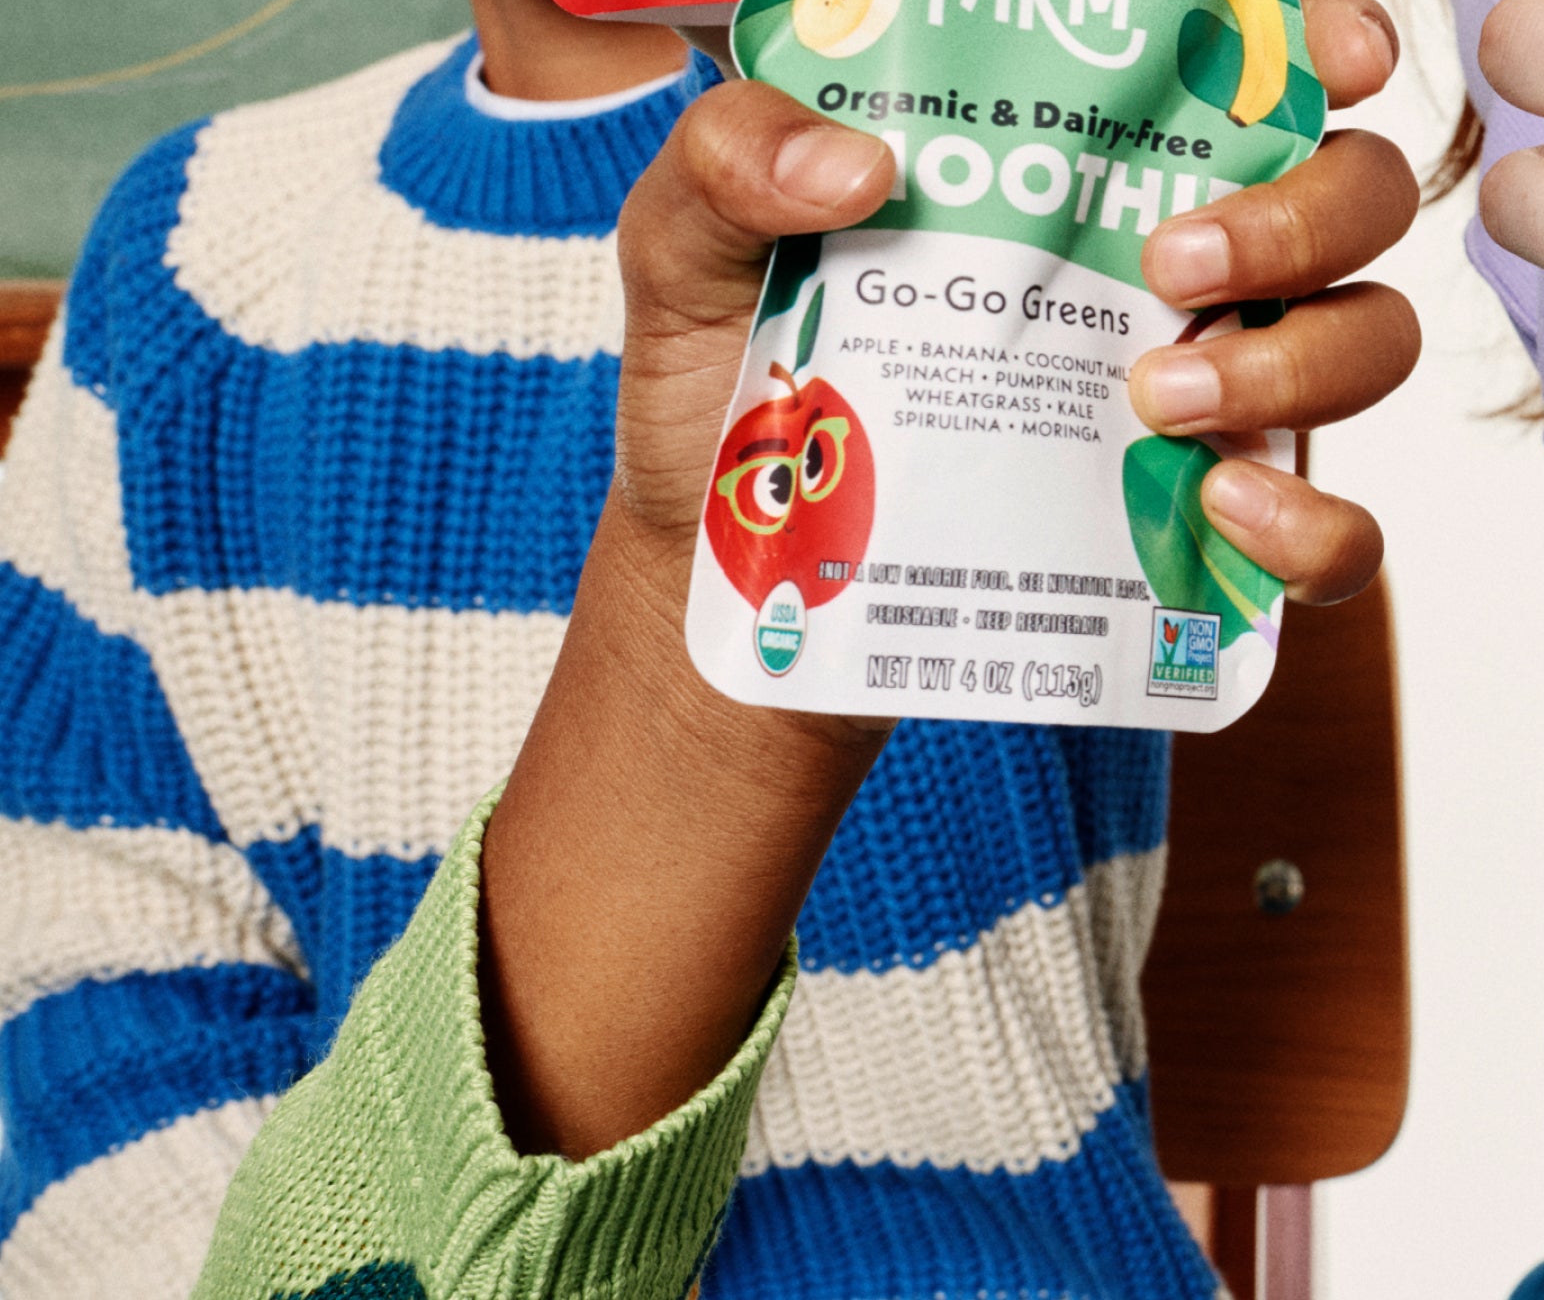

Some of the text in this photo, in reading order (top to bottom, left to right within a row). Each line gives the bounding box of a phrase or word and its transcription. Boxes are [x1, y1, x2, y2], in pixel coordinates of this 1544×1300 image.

[816, 82, 1214, 161] Organic & Dairy-Free
[879, 131, 1244, 237] OOTHI
[856, 269, 1131, 336] Go-Go Greens
[840, 338, 1103, 377] APPLE BANANA COCONUT
[881, 362, 1110, 400] SPINACH PUMPKIN SEED
[905, 388, 1094, 419] WHEATGRASS KALE
[893, 410, 1101, 443] SPIRULINA MORINGA
[868, 563, 900, 585] LOW
[904, 566, 967, 589] CALORIE
[1018, 571, 1044, 593] SEE
[867, 604, 1109, 636] PERISHABLE KEEP REFRIGERATED
[1190, 621, 1212, 636] NON
[1189, 635, 1213, 651] GMO
[867, 655, 1103, 708] NET WT 4 OZ (113g)
[1156, 665, 1214, 682] VERIFIED
